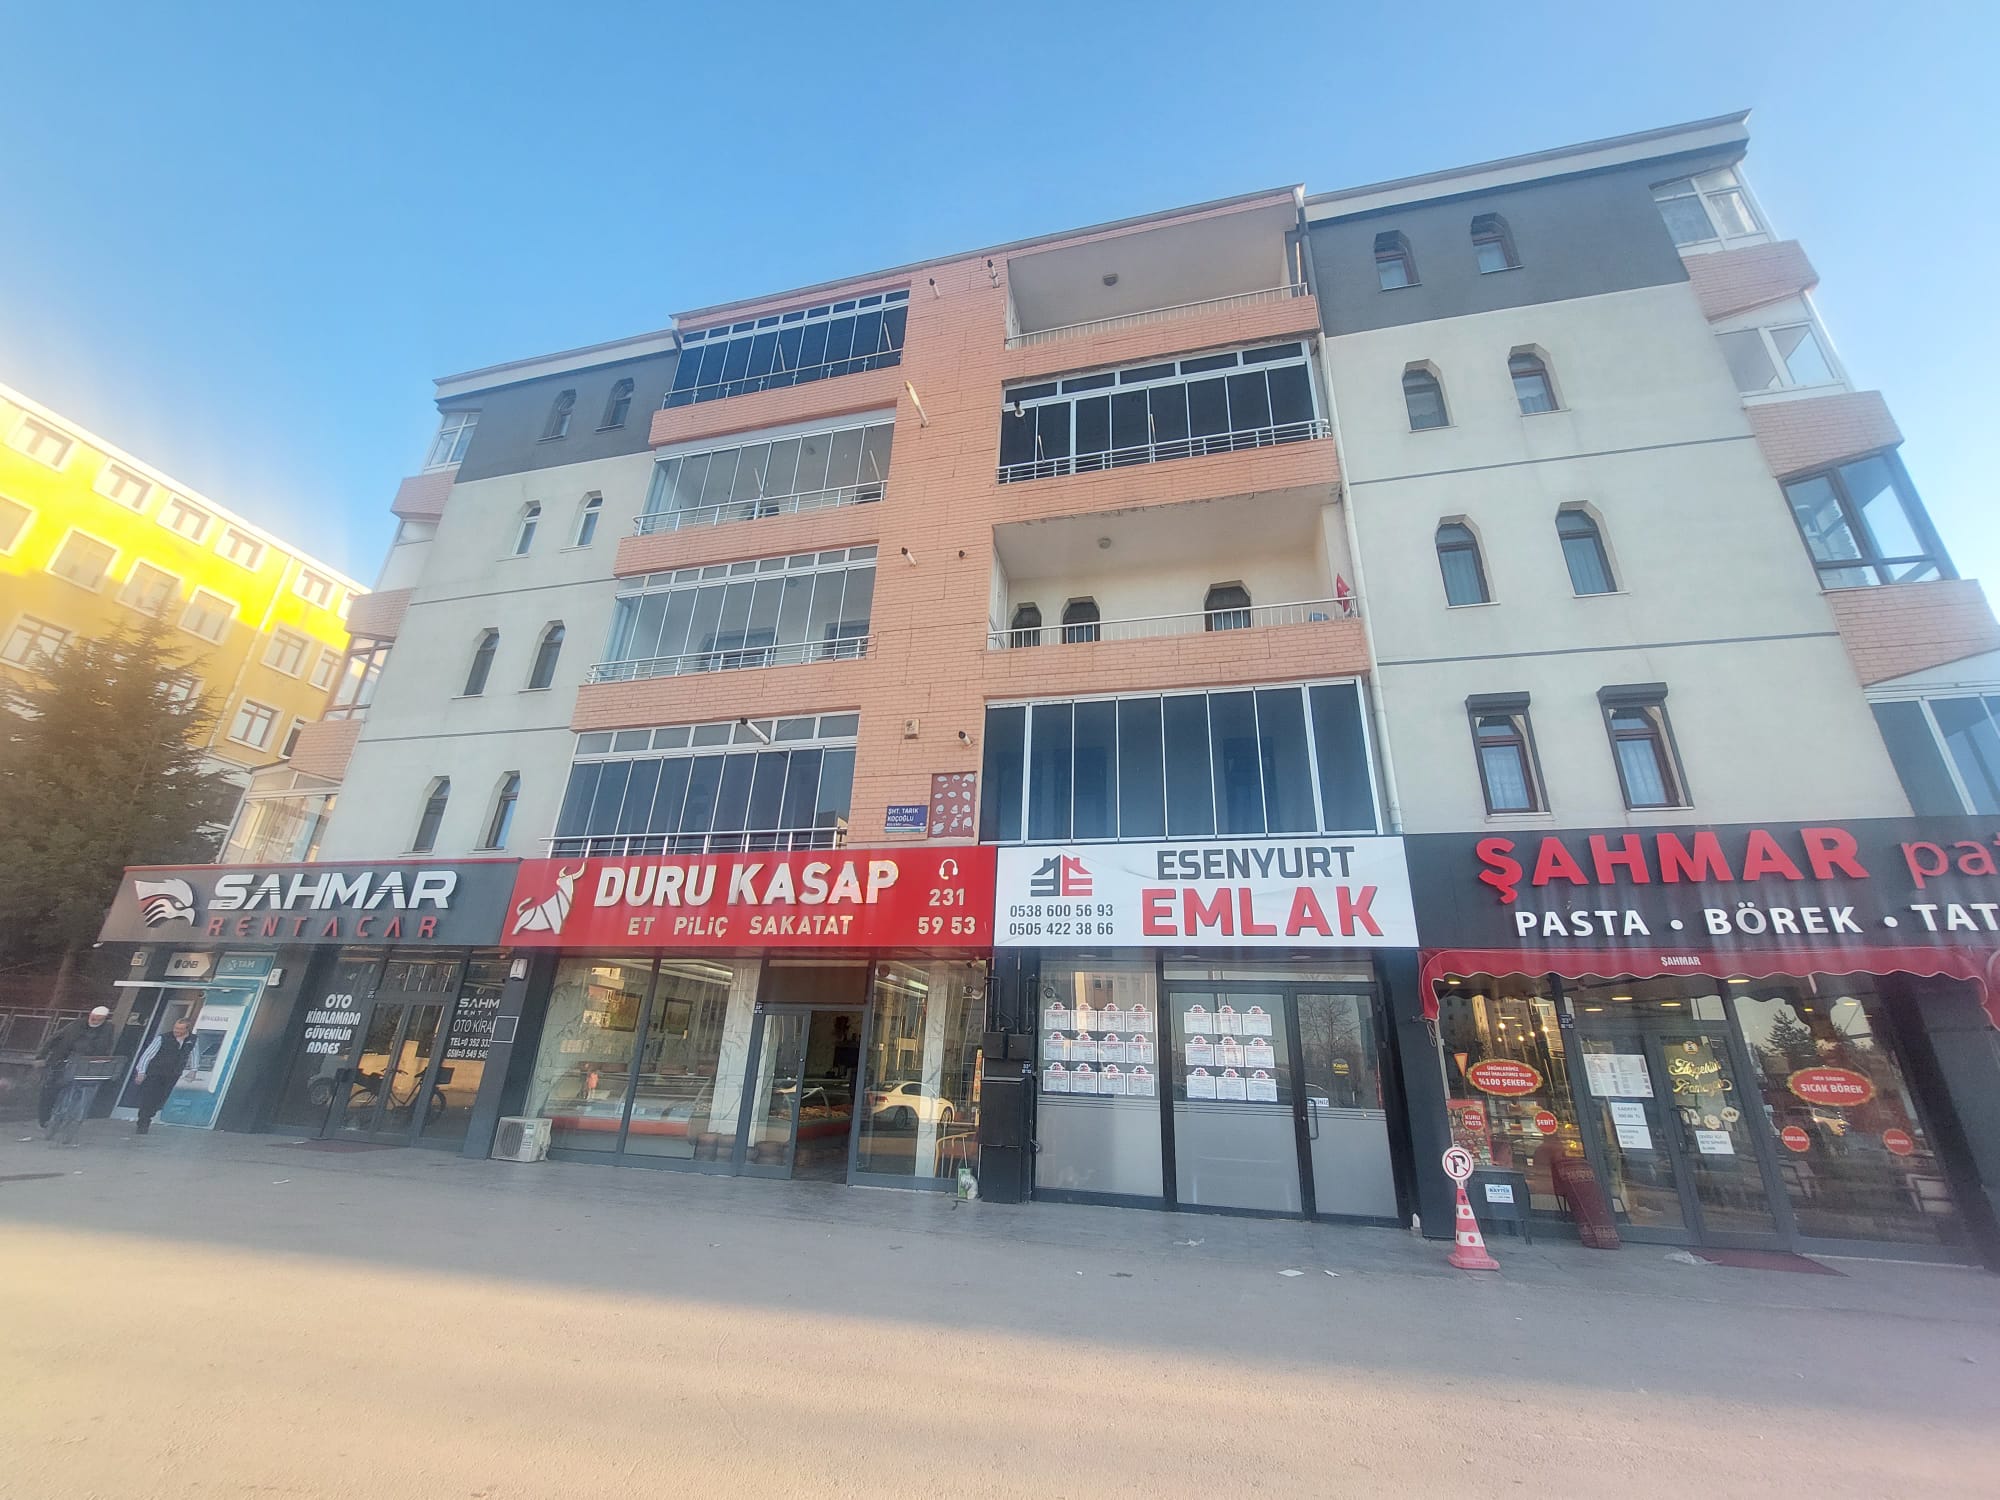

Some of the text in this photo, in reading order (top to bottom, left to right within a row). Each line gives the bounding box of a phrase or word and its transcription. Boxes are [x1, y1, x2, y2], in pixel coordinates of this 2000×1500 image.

[1157, 846, 1355, 880] ESENYURT
[1476, 827, 1869, 904] ŞAHMAR
[207, 870, 457, 910] SAHMAR
[594, 860, 899, 907] DURU KASAP
[928, 888, 965, 906] 231
[1010, 903, 1114, 917] 0538 600 56 93
[1142, 886, 1384, 937] EMLAK
[627, 916, 656, 936] ET
[749, 915, 854, 935] SAKATAT
[918, 916, 976, 935] 59 53
[1009, 922, 1114, 935] 0505 422 38 66
[1515, 902, 2000, 937] PASTA BÖREK TAT
[325, 994, 353, 1009] OTO
[453, 1019, 472, 1033] OTO
[306, 1041, 340, 1055] ADRES
[1478, 1078, 1500, 1086] %100
[1800, 1082, 1864, 1094] SICAK BÖREK
